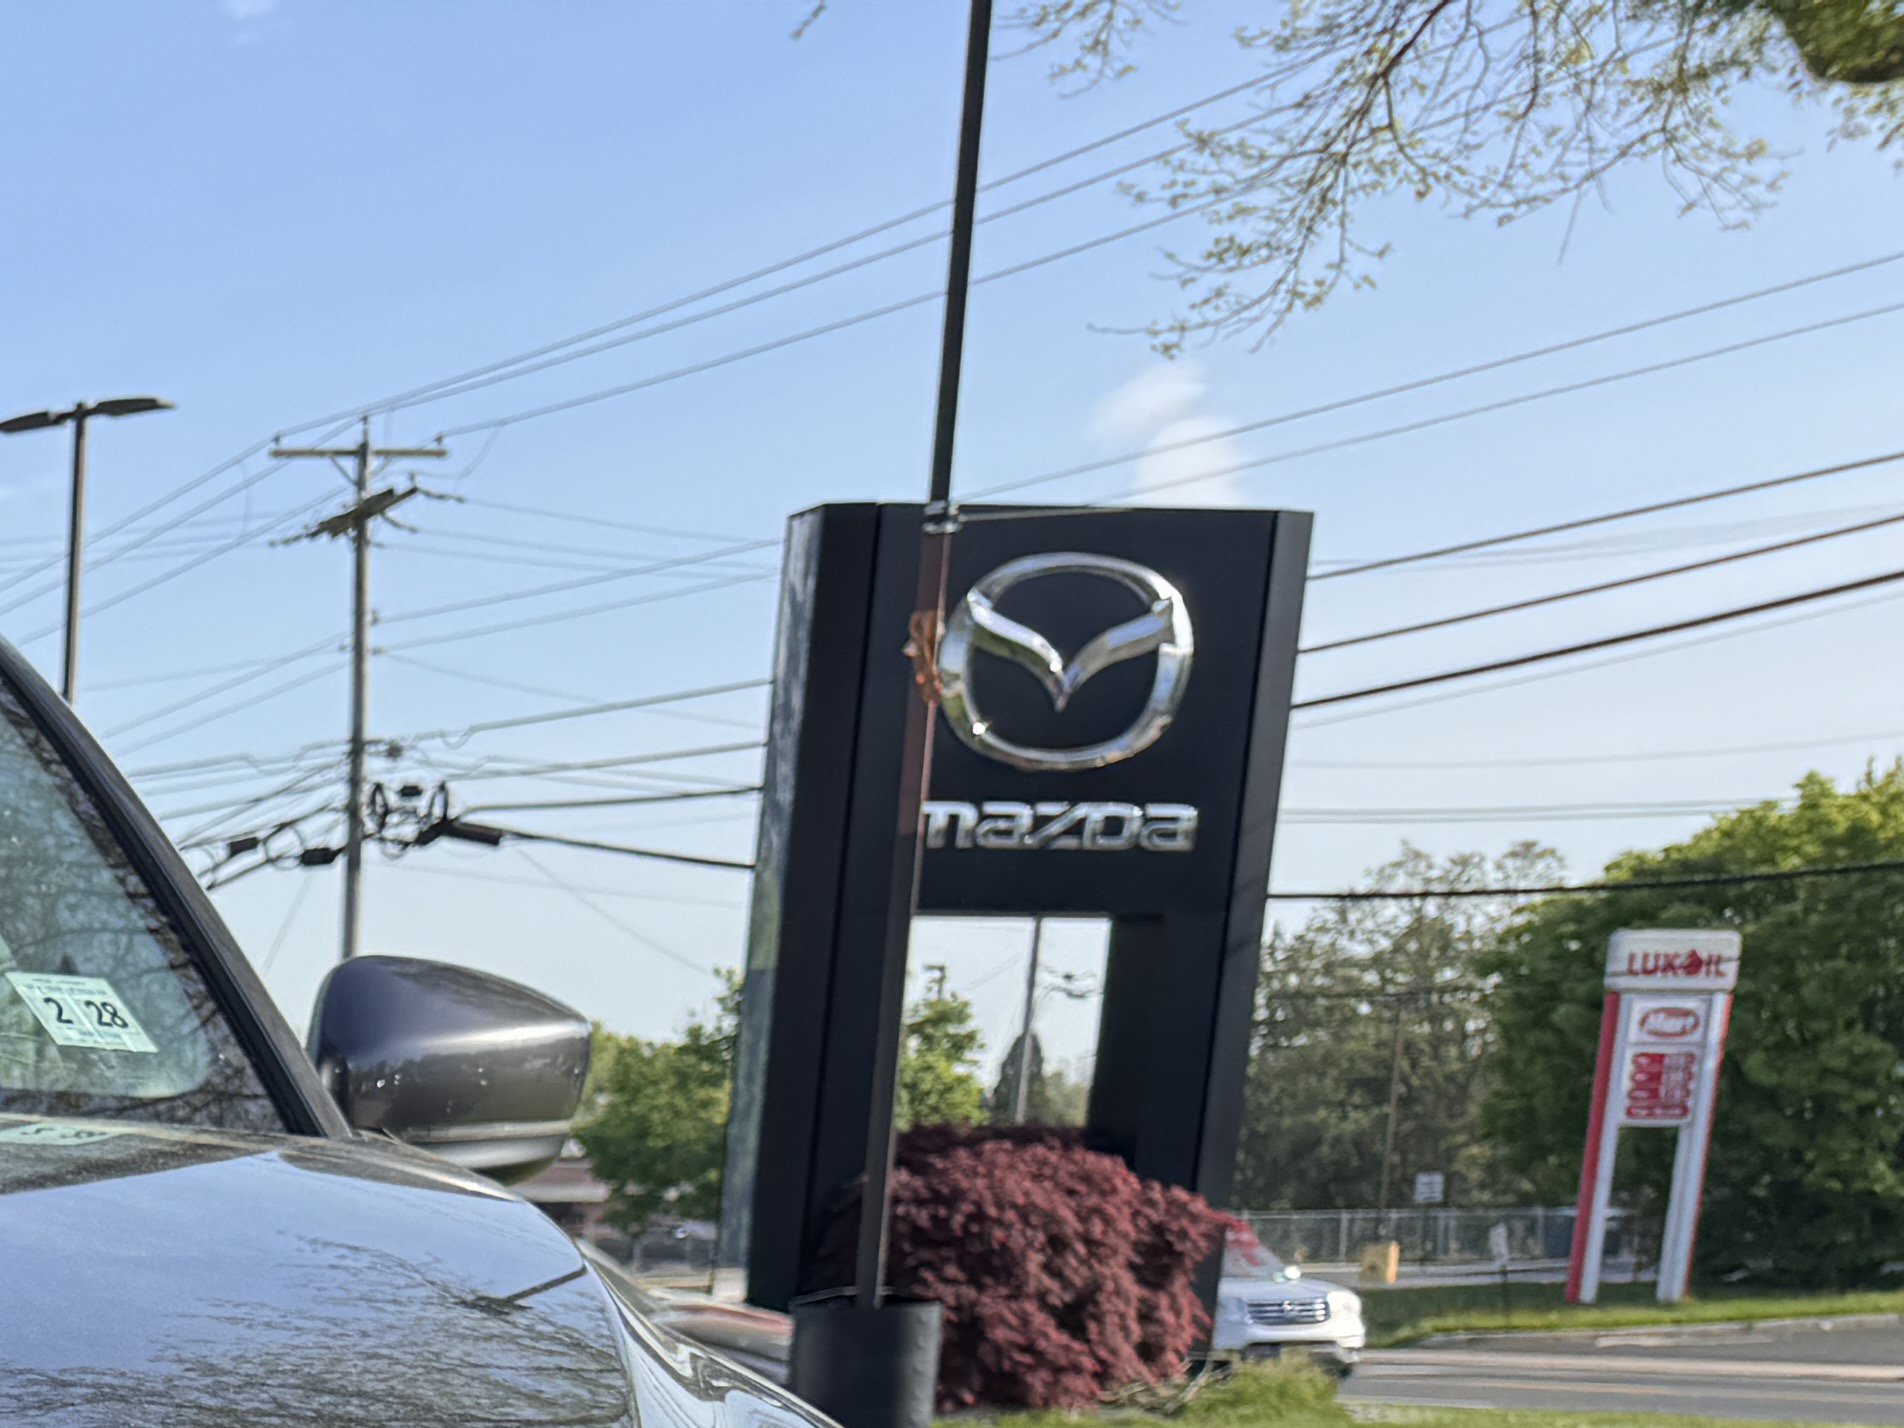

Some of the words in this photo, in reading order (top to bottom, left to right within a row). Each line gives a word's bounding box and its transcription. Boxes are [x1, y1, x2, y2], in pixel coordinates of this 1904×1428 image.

[922, 799, 1199, 853] mazda
[43, 996, 74, 1024] 2
[84, 1000, 129, 1029] 28
